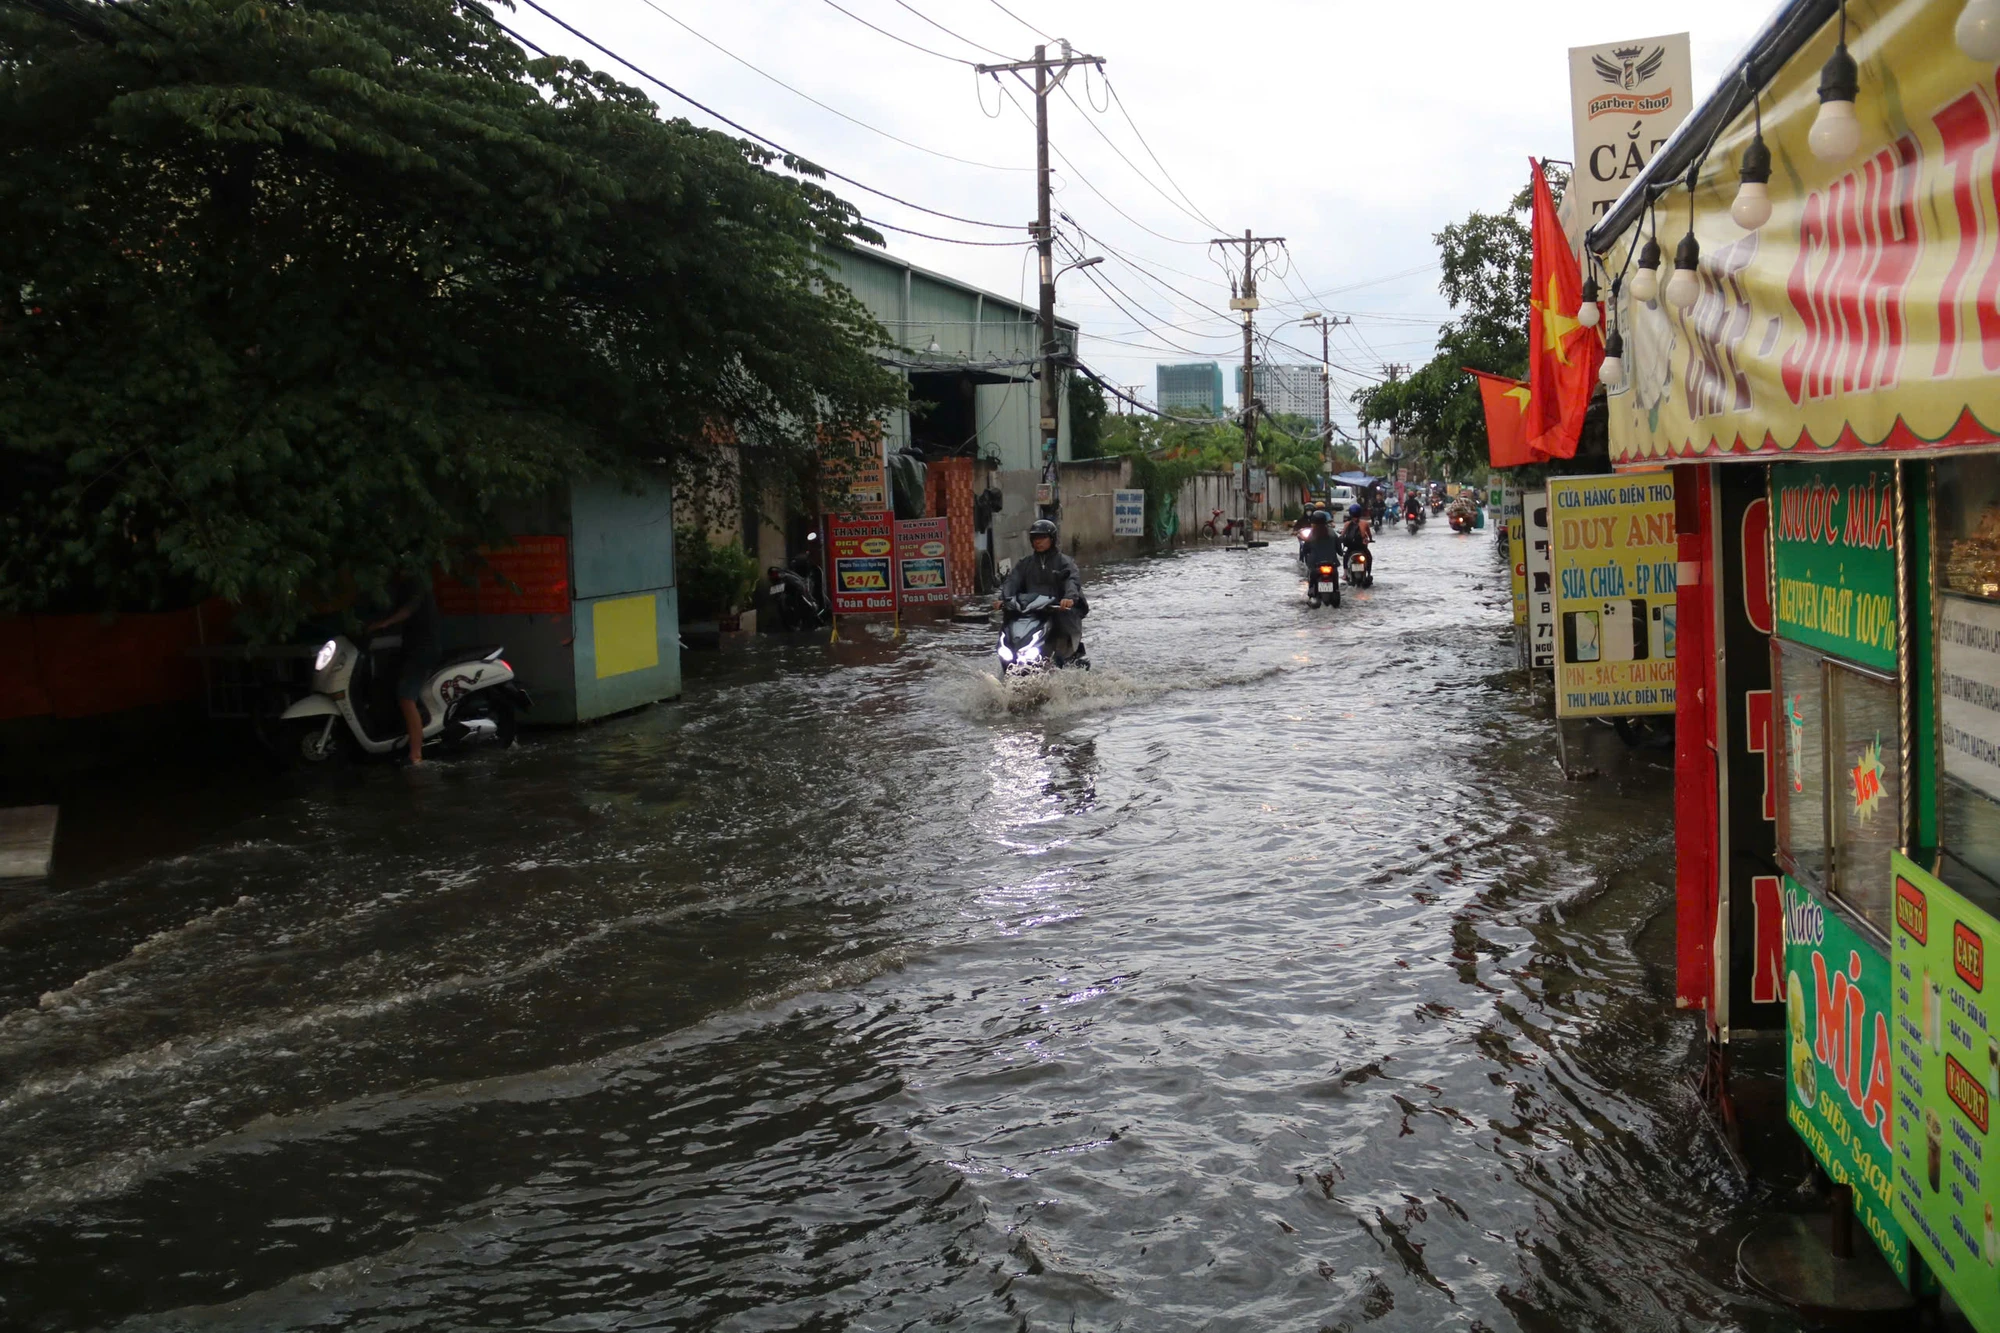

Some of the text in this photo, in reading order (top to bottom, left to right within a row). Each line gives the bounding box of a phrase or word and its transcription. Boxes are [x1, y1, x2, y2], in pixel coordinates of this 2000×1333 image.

[1591, 96, 1669, 114] Barber shop
[1781, 132, 1924, 405] SINH
[1558, 486, 1580, 508] CỬA
[1620, 484, 1645, 506] ĐIỆN
[1648, 485, 1675, 502] THO
[1778, 472, 1894, 550] NƯỚC MÍA
[834, 526, 868, 536] THANH
[898, 533, 926, 542] THANH
[1562, 516, 1618, 550] DUY
[846, 575, 880, 587] 24/7
[910, 574, 938, 586] 24/7
[1562, 558, 1587, 600] SỬA
[1590, 559, 1625, 598] CHỮA
[1636, 557, 1650, 595] ÉP
[836, 594, 892, 608] Toàn Quốc
[1780, 568, 1820, 630] NGUYÊN
[1821, 562, 1852, 638] CHẤT
[1856, 592, 1896, 651] 100%
[1566, 667, 1586, 686] PIN
[1628, 664, 1646, 682] TAI
[1567, 693, 1586, 708] THU
[1590, 691, 1610, 707] MUA
[1613, 688, 1632, 706] XÁC
[1636, 686, 1657, 706] ĐIỆN
[1786, 888, 1824, 946] Nước
[1898, 894, 1924, 936] SINH TỐ
[1956, 935, 1980, 978] CAFE
[1950, 987, 1966, 1012] CAFE
[1812, 950, 1892, 1153] MÍA
[1949, 1064, 1985, 1123] YAOURT
[1820, 1090, 1893, 1210] SIÊU SẠCH
[1790, 1101, 1832, 1168] NGUYÊN
[1866, 1207, 1904, 1274] 100%
